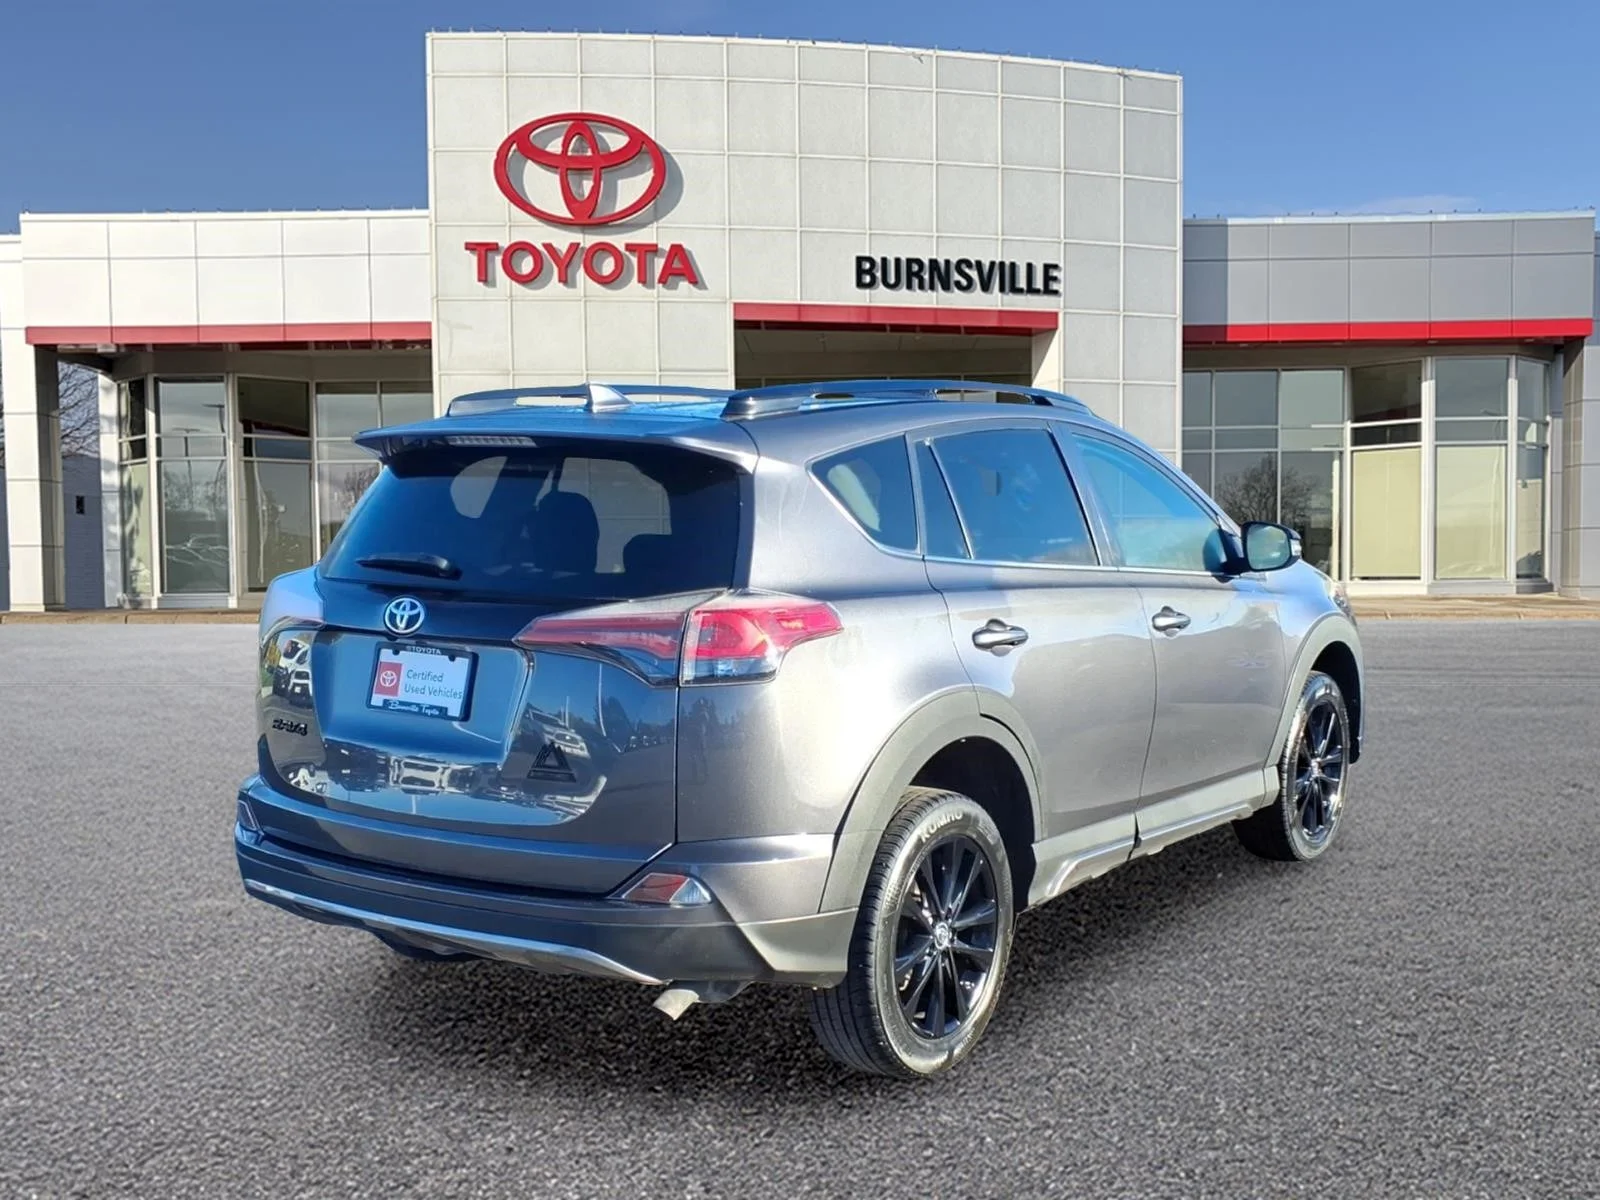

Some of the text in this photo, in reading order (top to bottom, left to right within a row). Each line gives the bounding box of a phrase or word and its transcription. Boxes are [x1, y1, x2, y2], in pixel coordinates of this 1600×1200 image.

[464, 241, 699, 285] TOYOTA
[855, 255, 1061, 296] BURNSVILLE
[411, 645, 442, 655] TOYOTA
[406, 669, 444, 682] Certified
[404, 683, 463, 699] Used Vehicles
